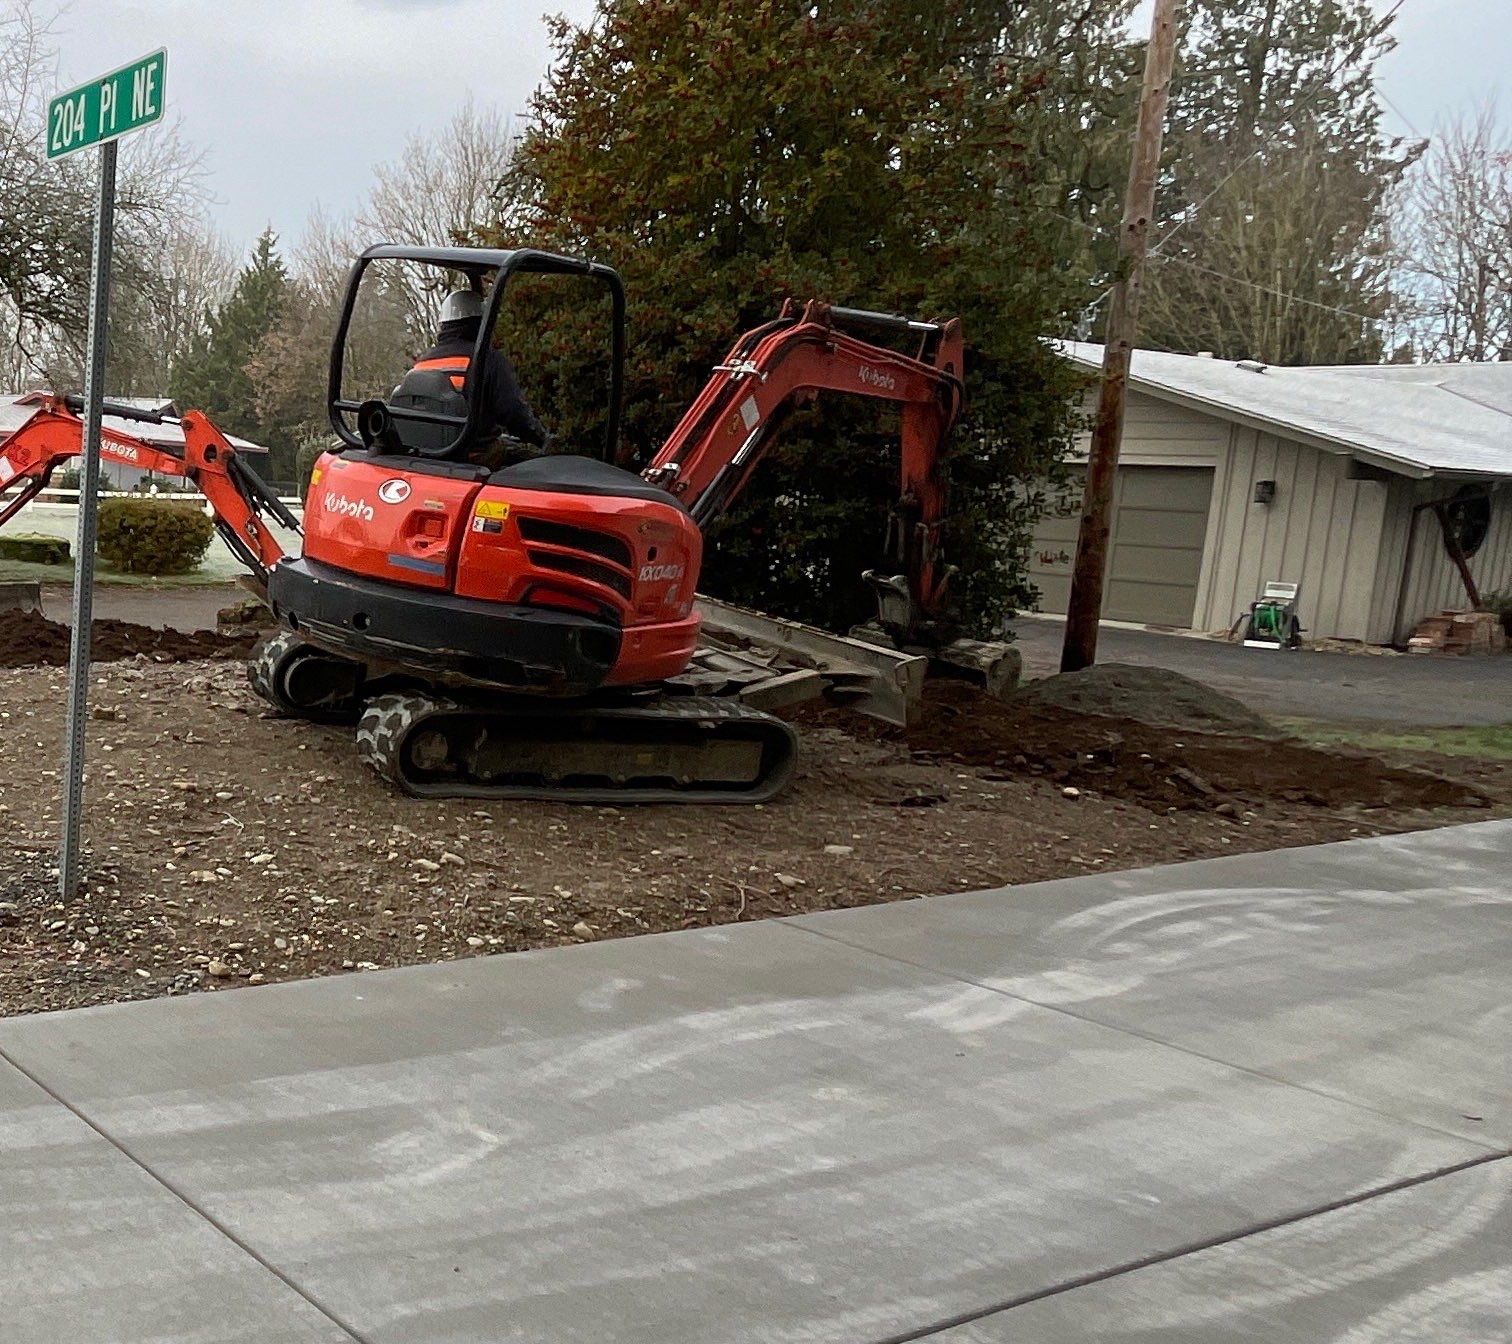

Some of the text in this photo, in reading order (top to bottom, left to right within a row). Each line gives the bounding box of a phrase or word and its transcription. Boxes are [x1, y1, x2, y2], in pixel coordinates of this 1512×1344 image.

[52, 93, 86, 151] 204
[131, 61, 158, 122] NE
[858, 365, 896, 390] Kubota
[324, 492, 375, 521] Kubota
